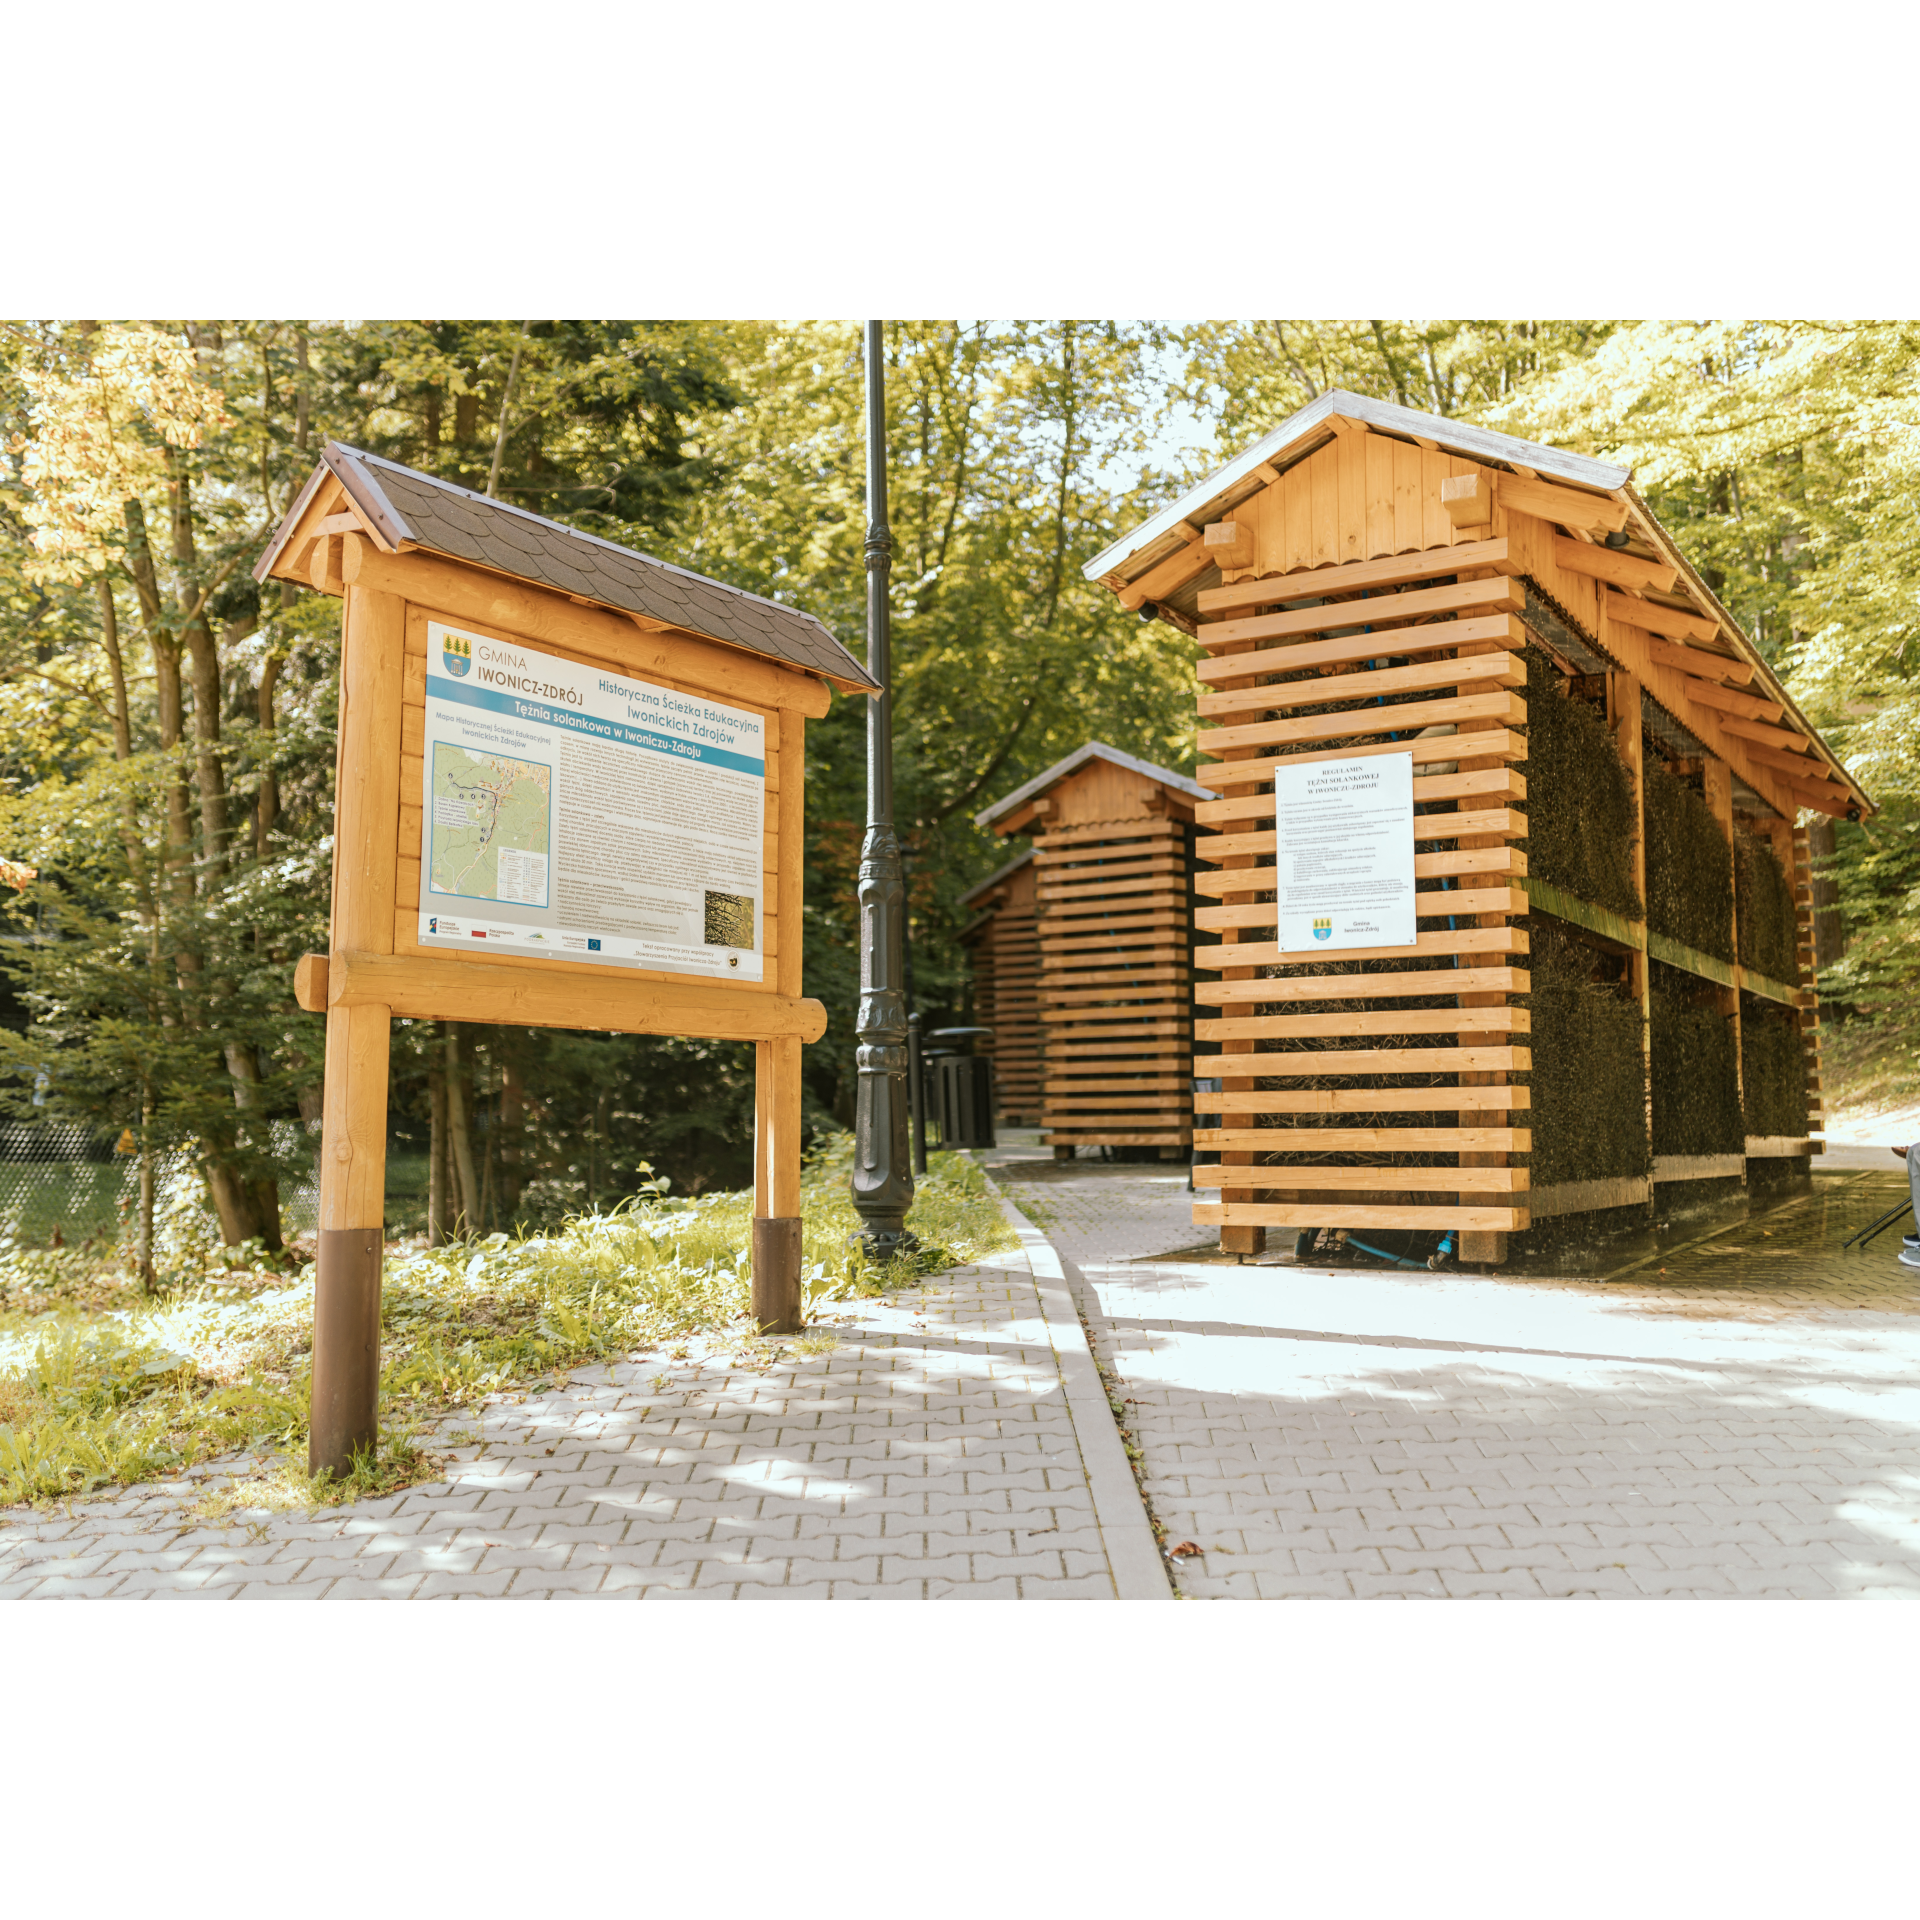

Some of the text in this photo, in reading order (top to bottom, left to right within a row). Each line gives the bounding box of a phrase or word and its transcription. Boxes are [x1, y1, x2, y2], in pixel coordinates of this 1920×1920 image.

[478, 645, 527, 671] GMINA
[478, 666, 583, 706] IWONICZ-ZDRÓJ
[599, 679, 759, 733] Historyczna Ścieżka Edukacyjna
[435, 711, 551, 746] Mapa Historycznej Ścieżki Edukacyjnej
[462, 727, 527, 748] Iwonickich Zdrojów
[515, 700, 701, 759] Tężnia solankowa w Iwoniczu-Zdroju
[628, 705, 735, 744] Iwonickich Zdrojów
[1307, 773, 1379, 787] TĘŻNI SOLANKOWEJ
[1322, 766, 1363, 776] REGULAMIN
[1315, 782, 1377, 794] IWONICZU-ZDROJU
[654, 945, 681, 954] opracowany
